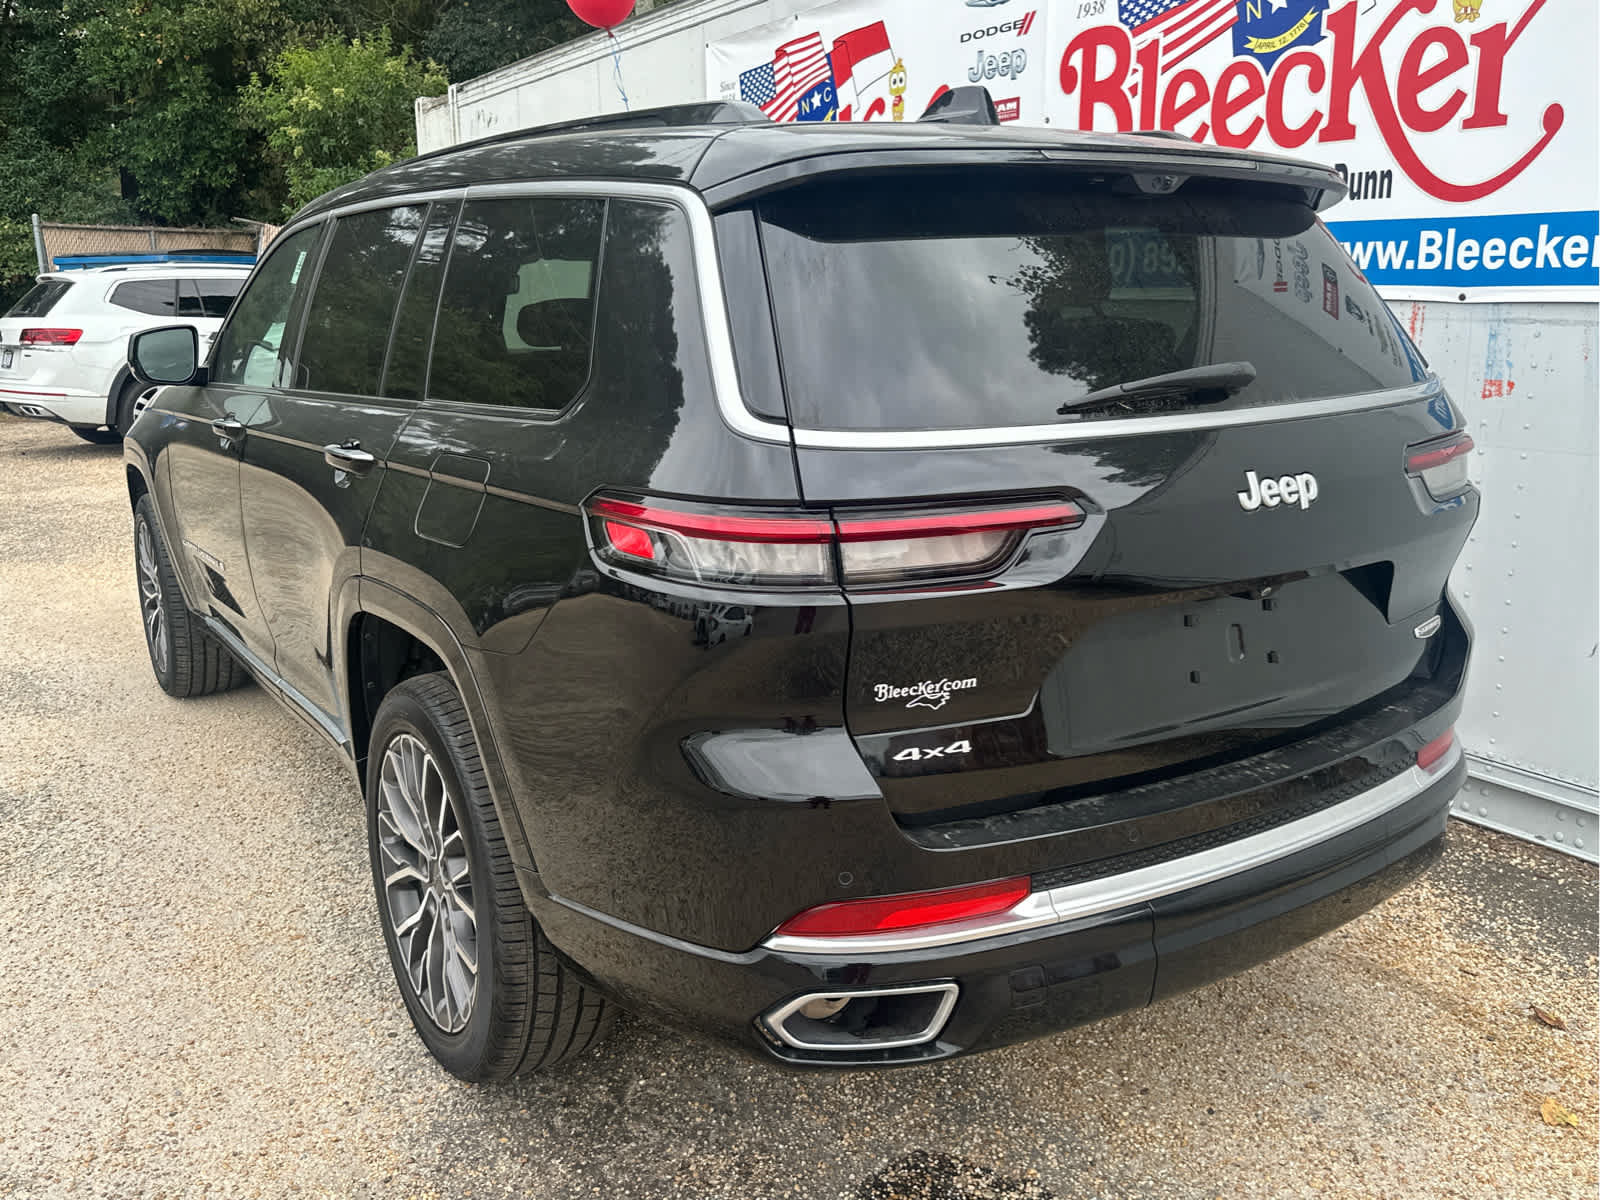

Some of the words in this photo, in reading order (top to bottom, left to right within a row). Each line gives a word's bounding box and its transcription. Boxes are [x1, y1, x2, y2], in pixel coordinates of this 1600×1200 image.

[1076, 0, 1107, 20] 1938
[960, 18, 1025, 43] DODGE
[968, 48, 1027, 83] Jeep
[1237, 471, 1319, 511] Jeep
[893, 740, 973, 760] 4x4
